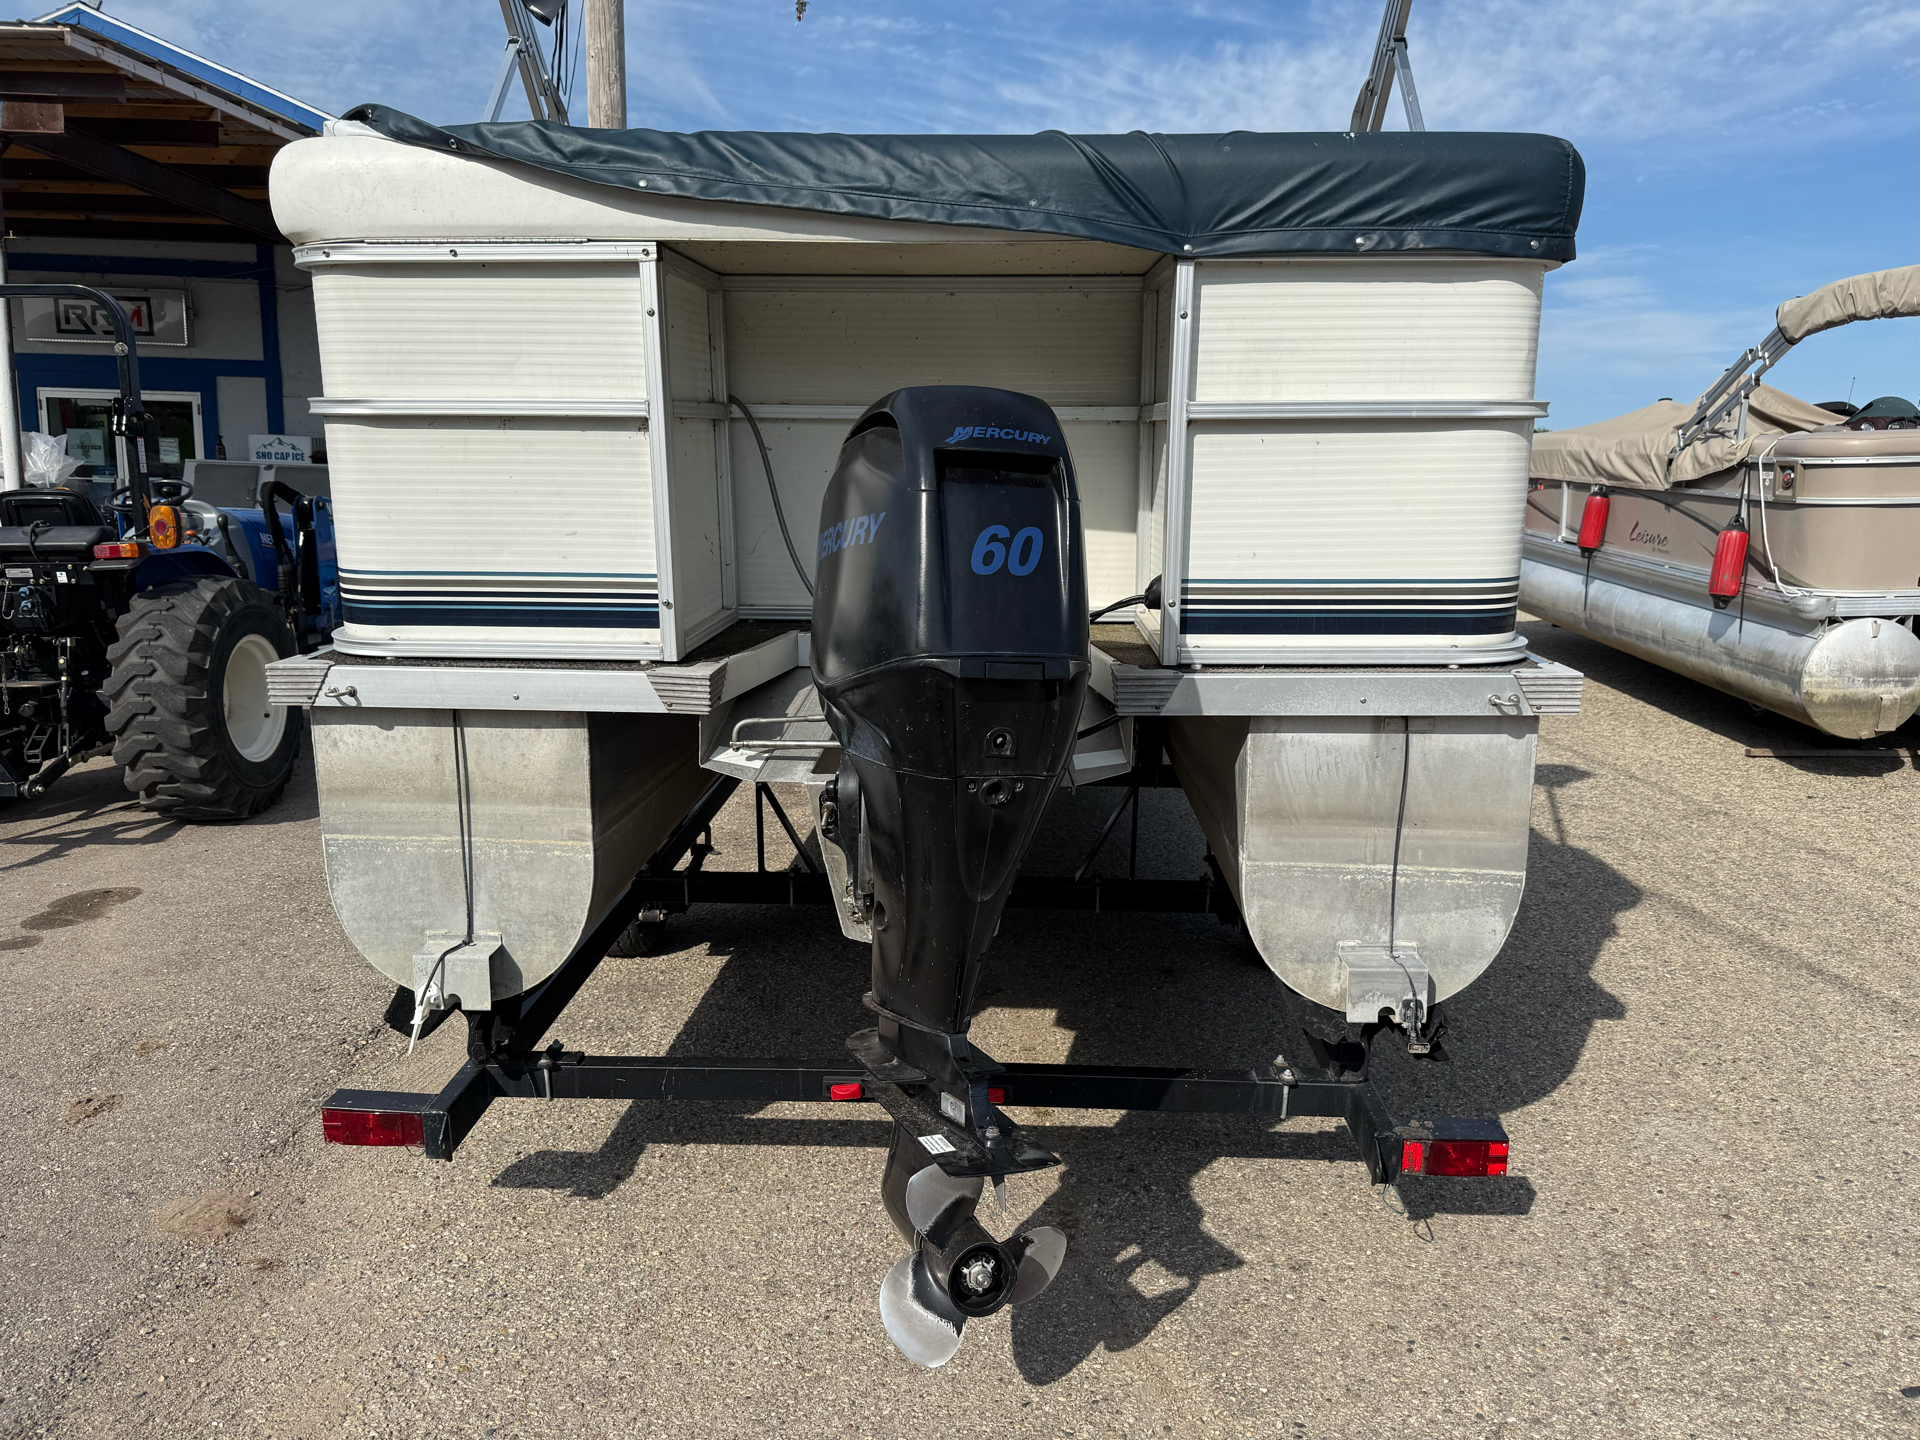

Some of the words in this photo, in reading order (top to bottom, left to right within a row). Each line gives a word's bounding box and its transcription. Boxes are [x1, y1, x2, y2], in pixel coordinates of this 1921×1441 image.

[945, 426, 1051, 444] MERCURY
[256, 451, 272, 460] SNO
[274, 451, 290, 461] CAP
[292, 452, 305, 461] ICE
[1629, 520, 1669, 547] Leisure
[971, 524, 1044, 577] 60
